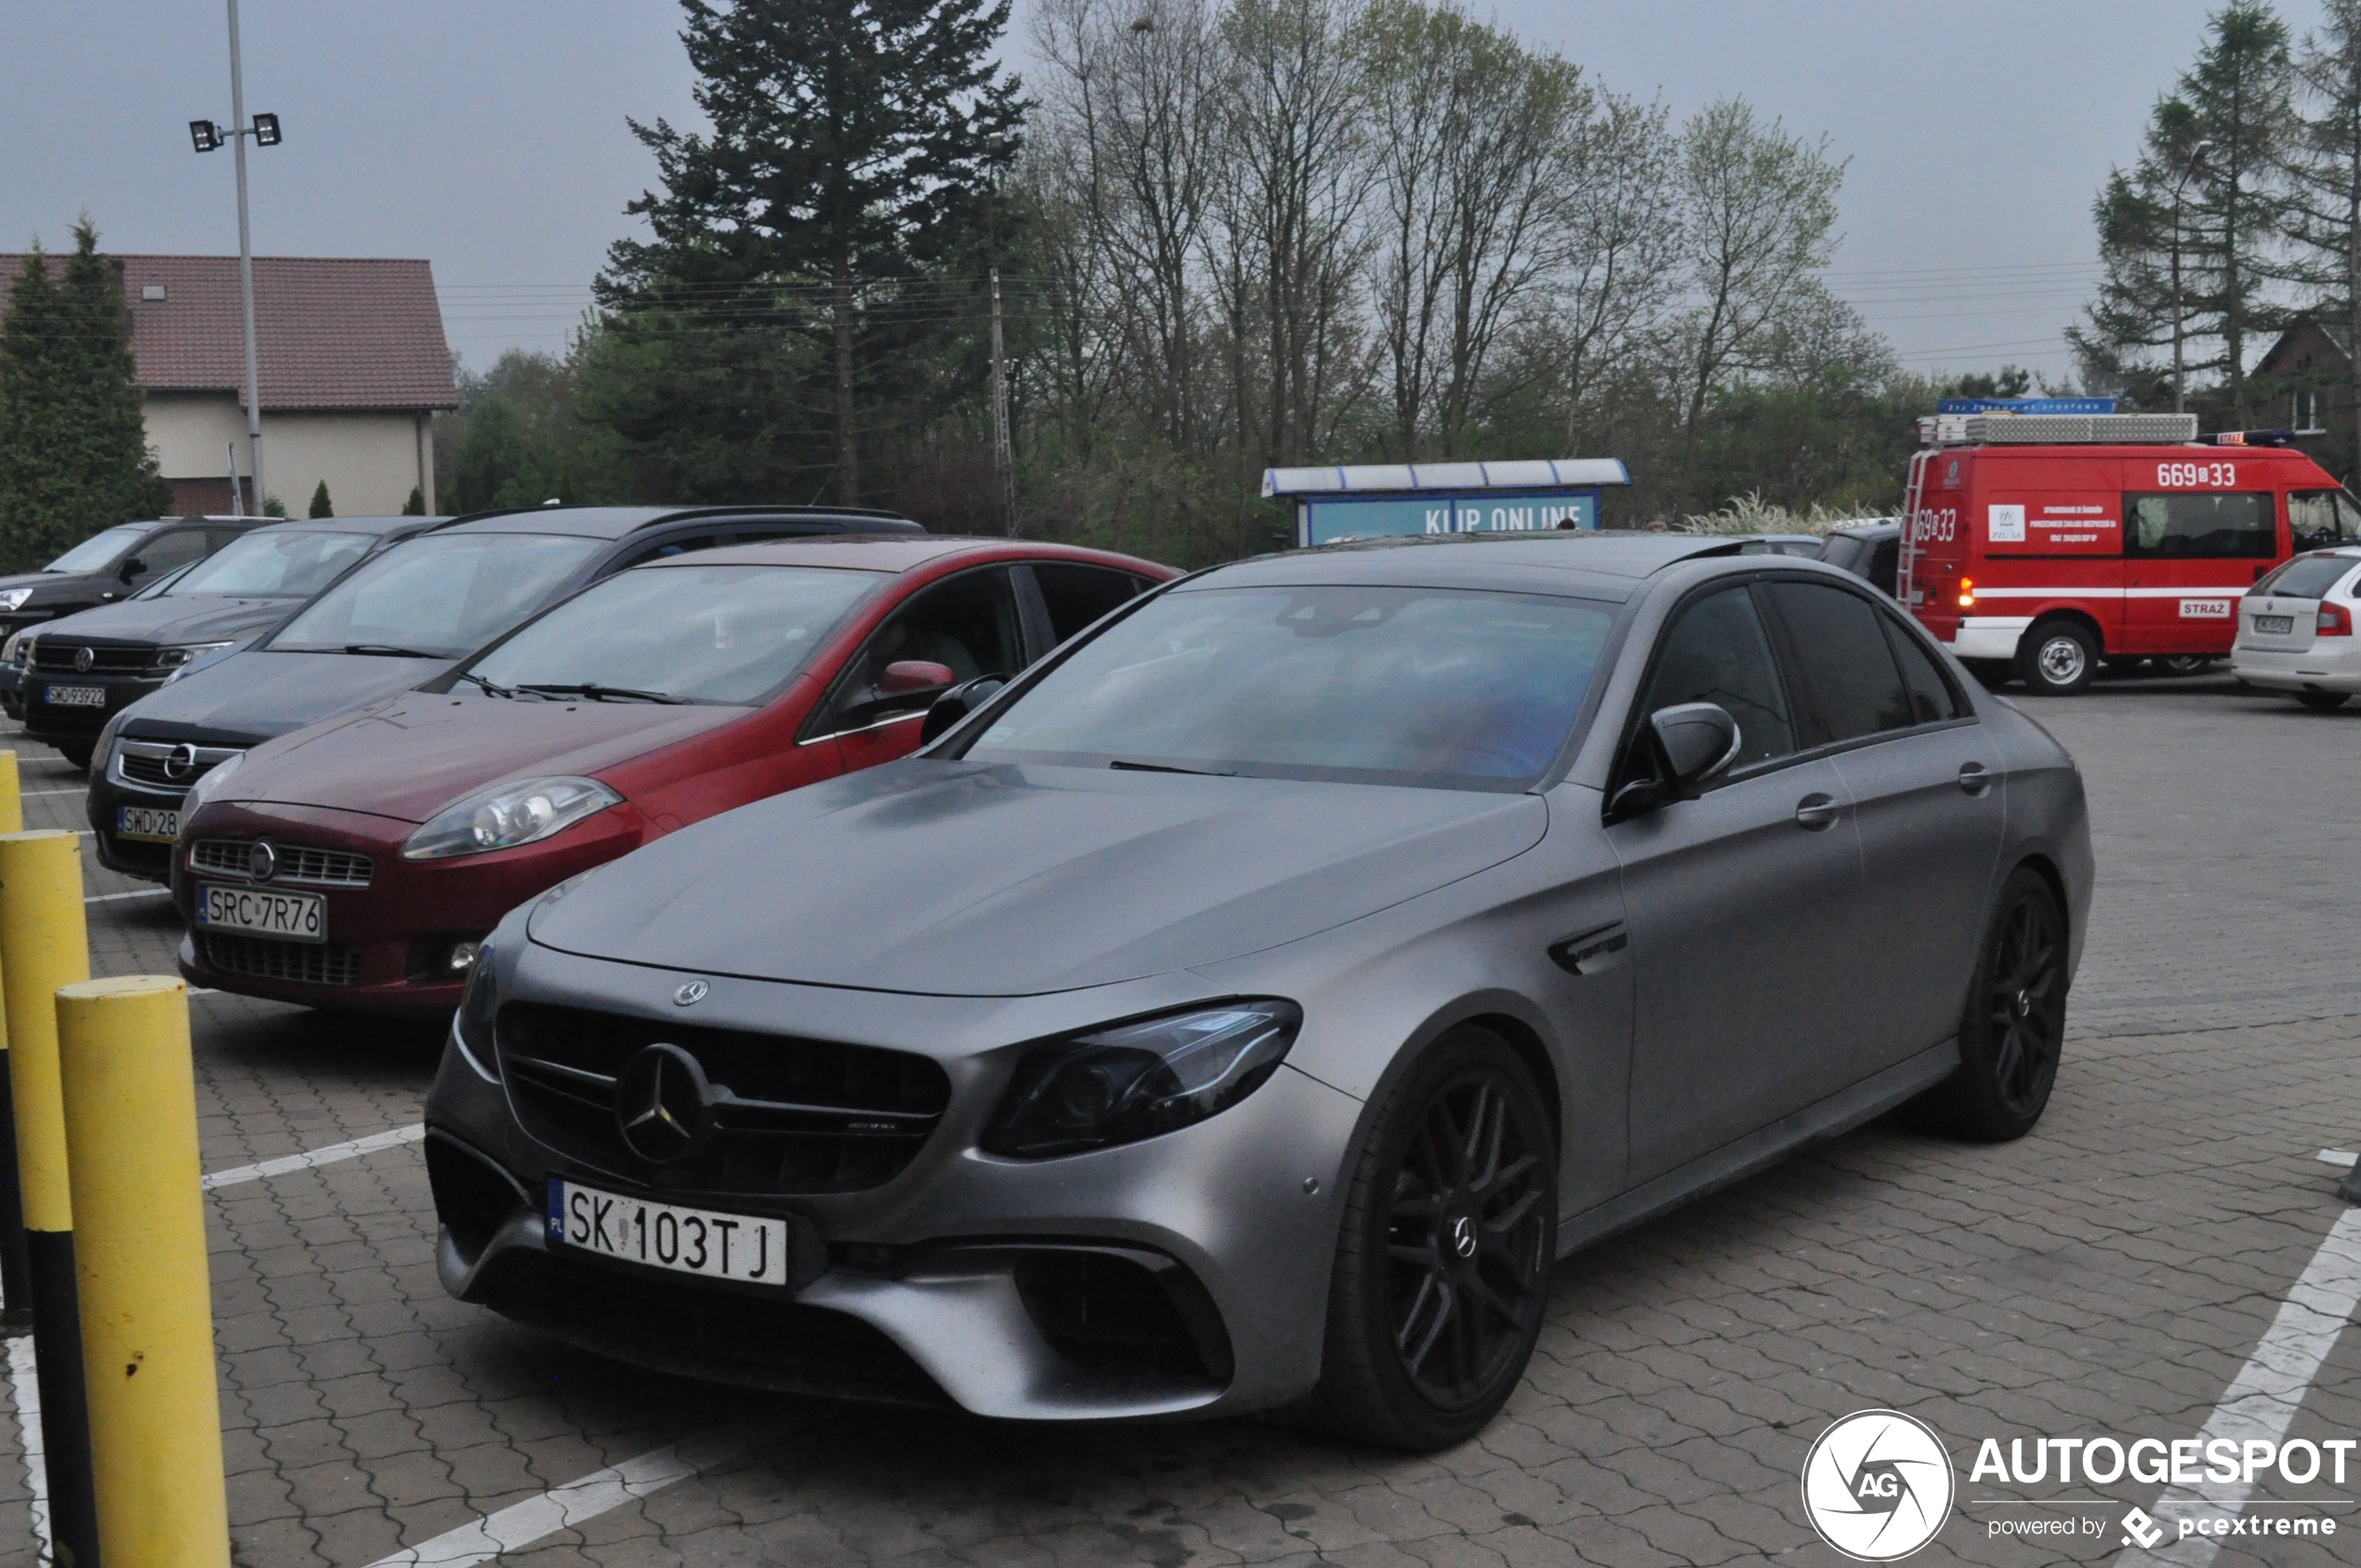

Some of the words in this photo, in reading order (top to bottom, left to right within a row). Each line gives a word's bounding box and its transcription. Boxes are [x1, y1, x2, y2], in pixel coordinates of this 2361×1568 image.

[2184, 601, 2224, 614] STRAŻ
[125, 809, 152, 834] SWD
[157, 811, 178, 836] 28
[210, 890, 252, 925] SRC
[261, 896, 319, 932] 7R76
[570, 1191, 613, 1252] SK
